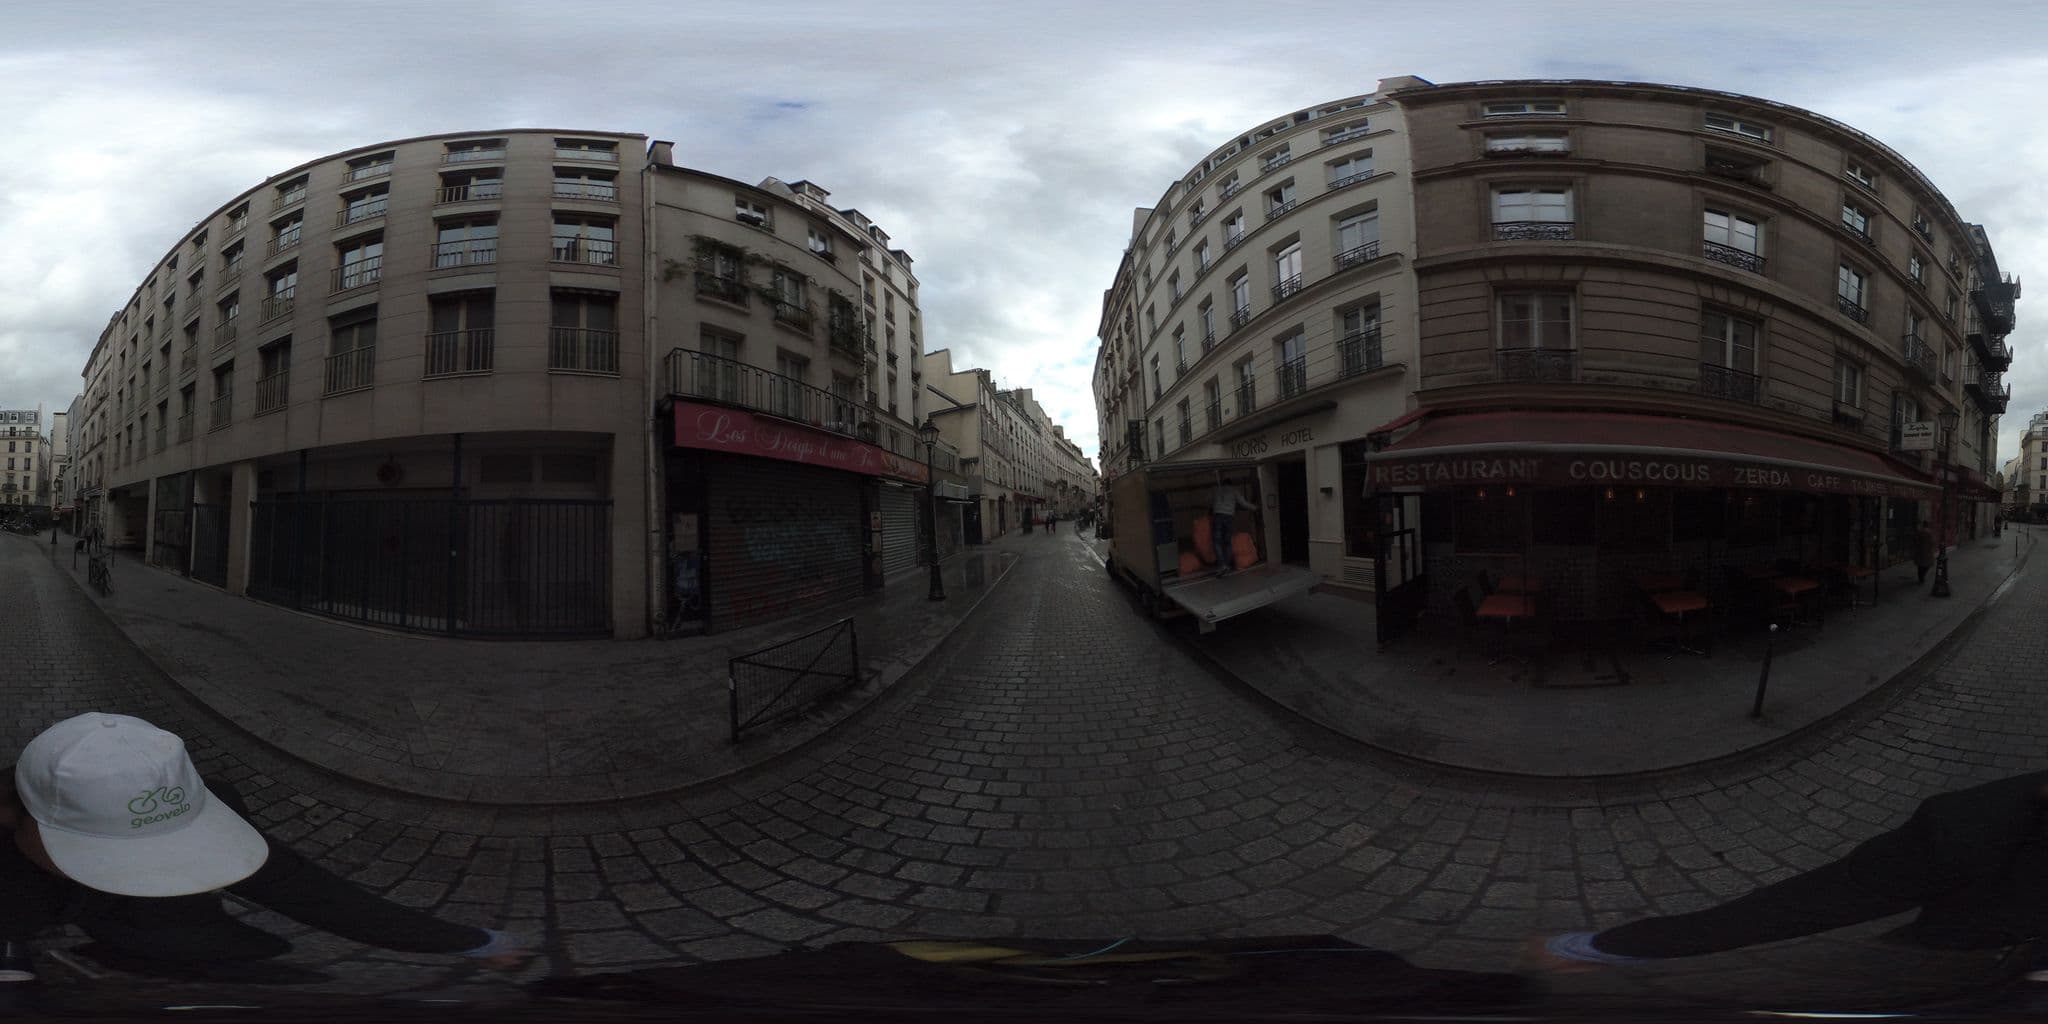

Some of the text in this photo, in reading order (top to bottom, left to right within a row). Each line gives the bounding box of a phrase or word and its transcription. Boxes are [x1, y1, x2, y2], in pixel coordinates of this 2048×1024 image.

[697, 410, 745, 444] Les
[1231, 427, 1314, 458] MORIS HOTEL
[1375, 458, 1542, 483] RESTAURANT
[1569, 460, 1711, 481] COUSCOUS
[1733, 467, 1792, 487] ZERDA
[130, 803, 191, 829] geovelo
